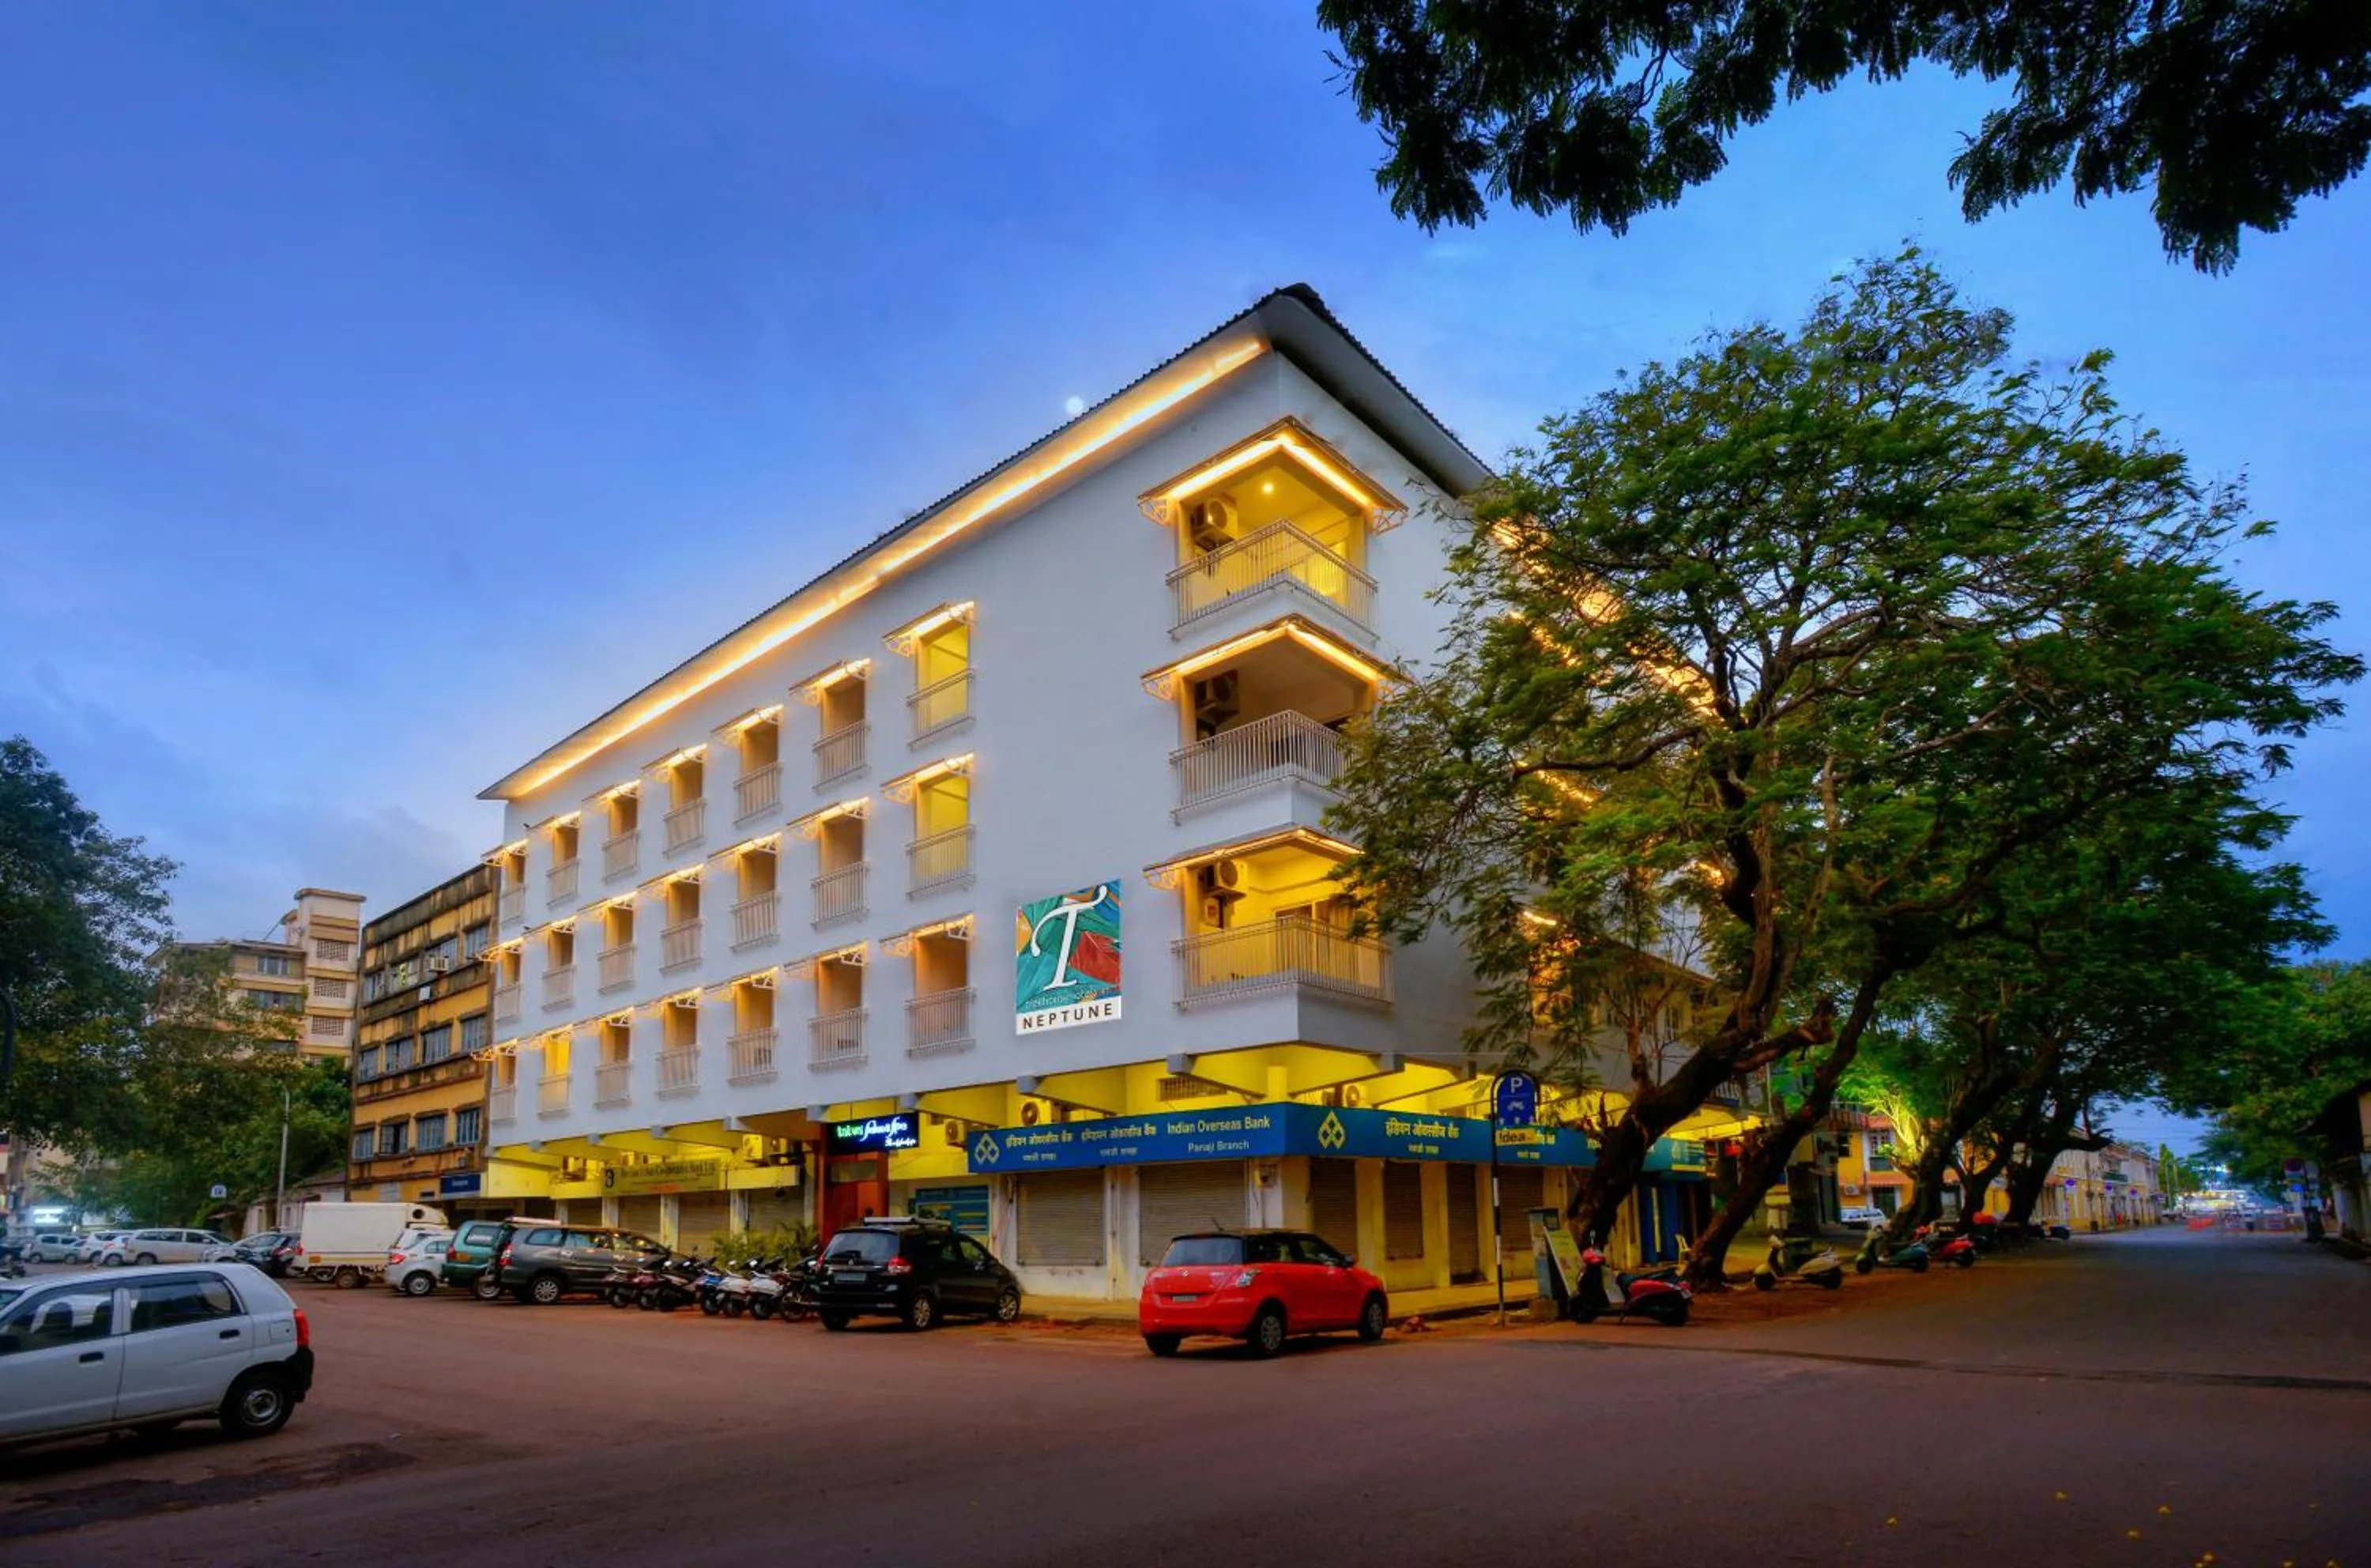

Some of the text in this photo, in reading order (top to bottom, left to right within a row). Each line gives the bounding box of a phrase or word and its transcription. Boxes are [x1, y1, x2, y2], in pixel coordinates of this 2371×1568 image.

[1023, 1003, 1112, 1029] NEPTUNE
[1510, 1077, 1523, 1094] P
[1167, 1114, 1270, 1135] Indian Overseas Bank
[1188, 1140, 1250, 1153] Panaji Branch
